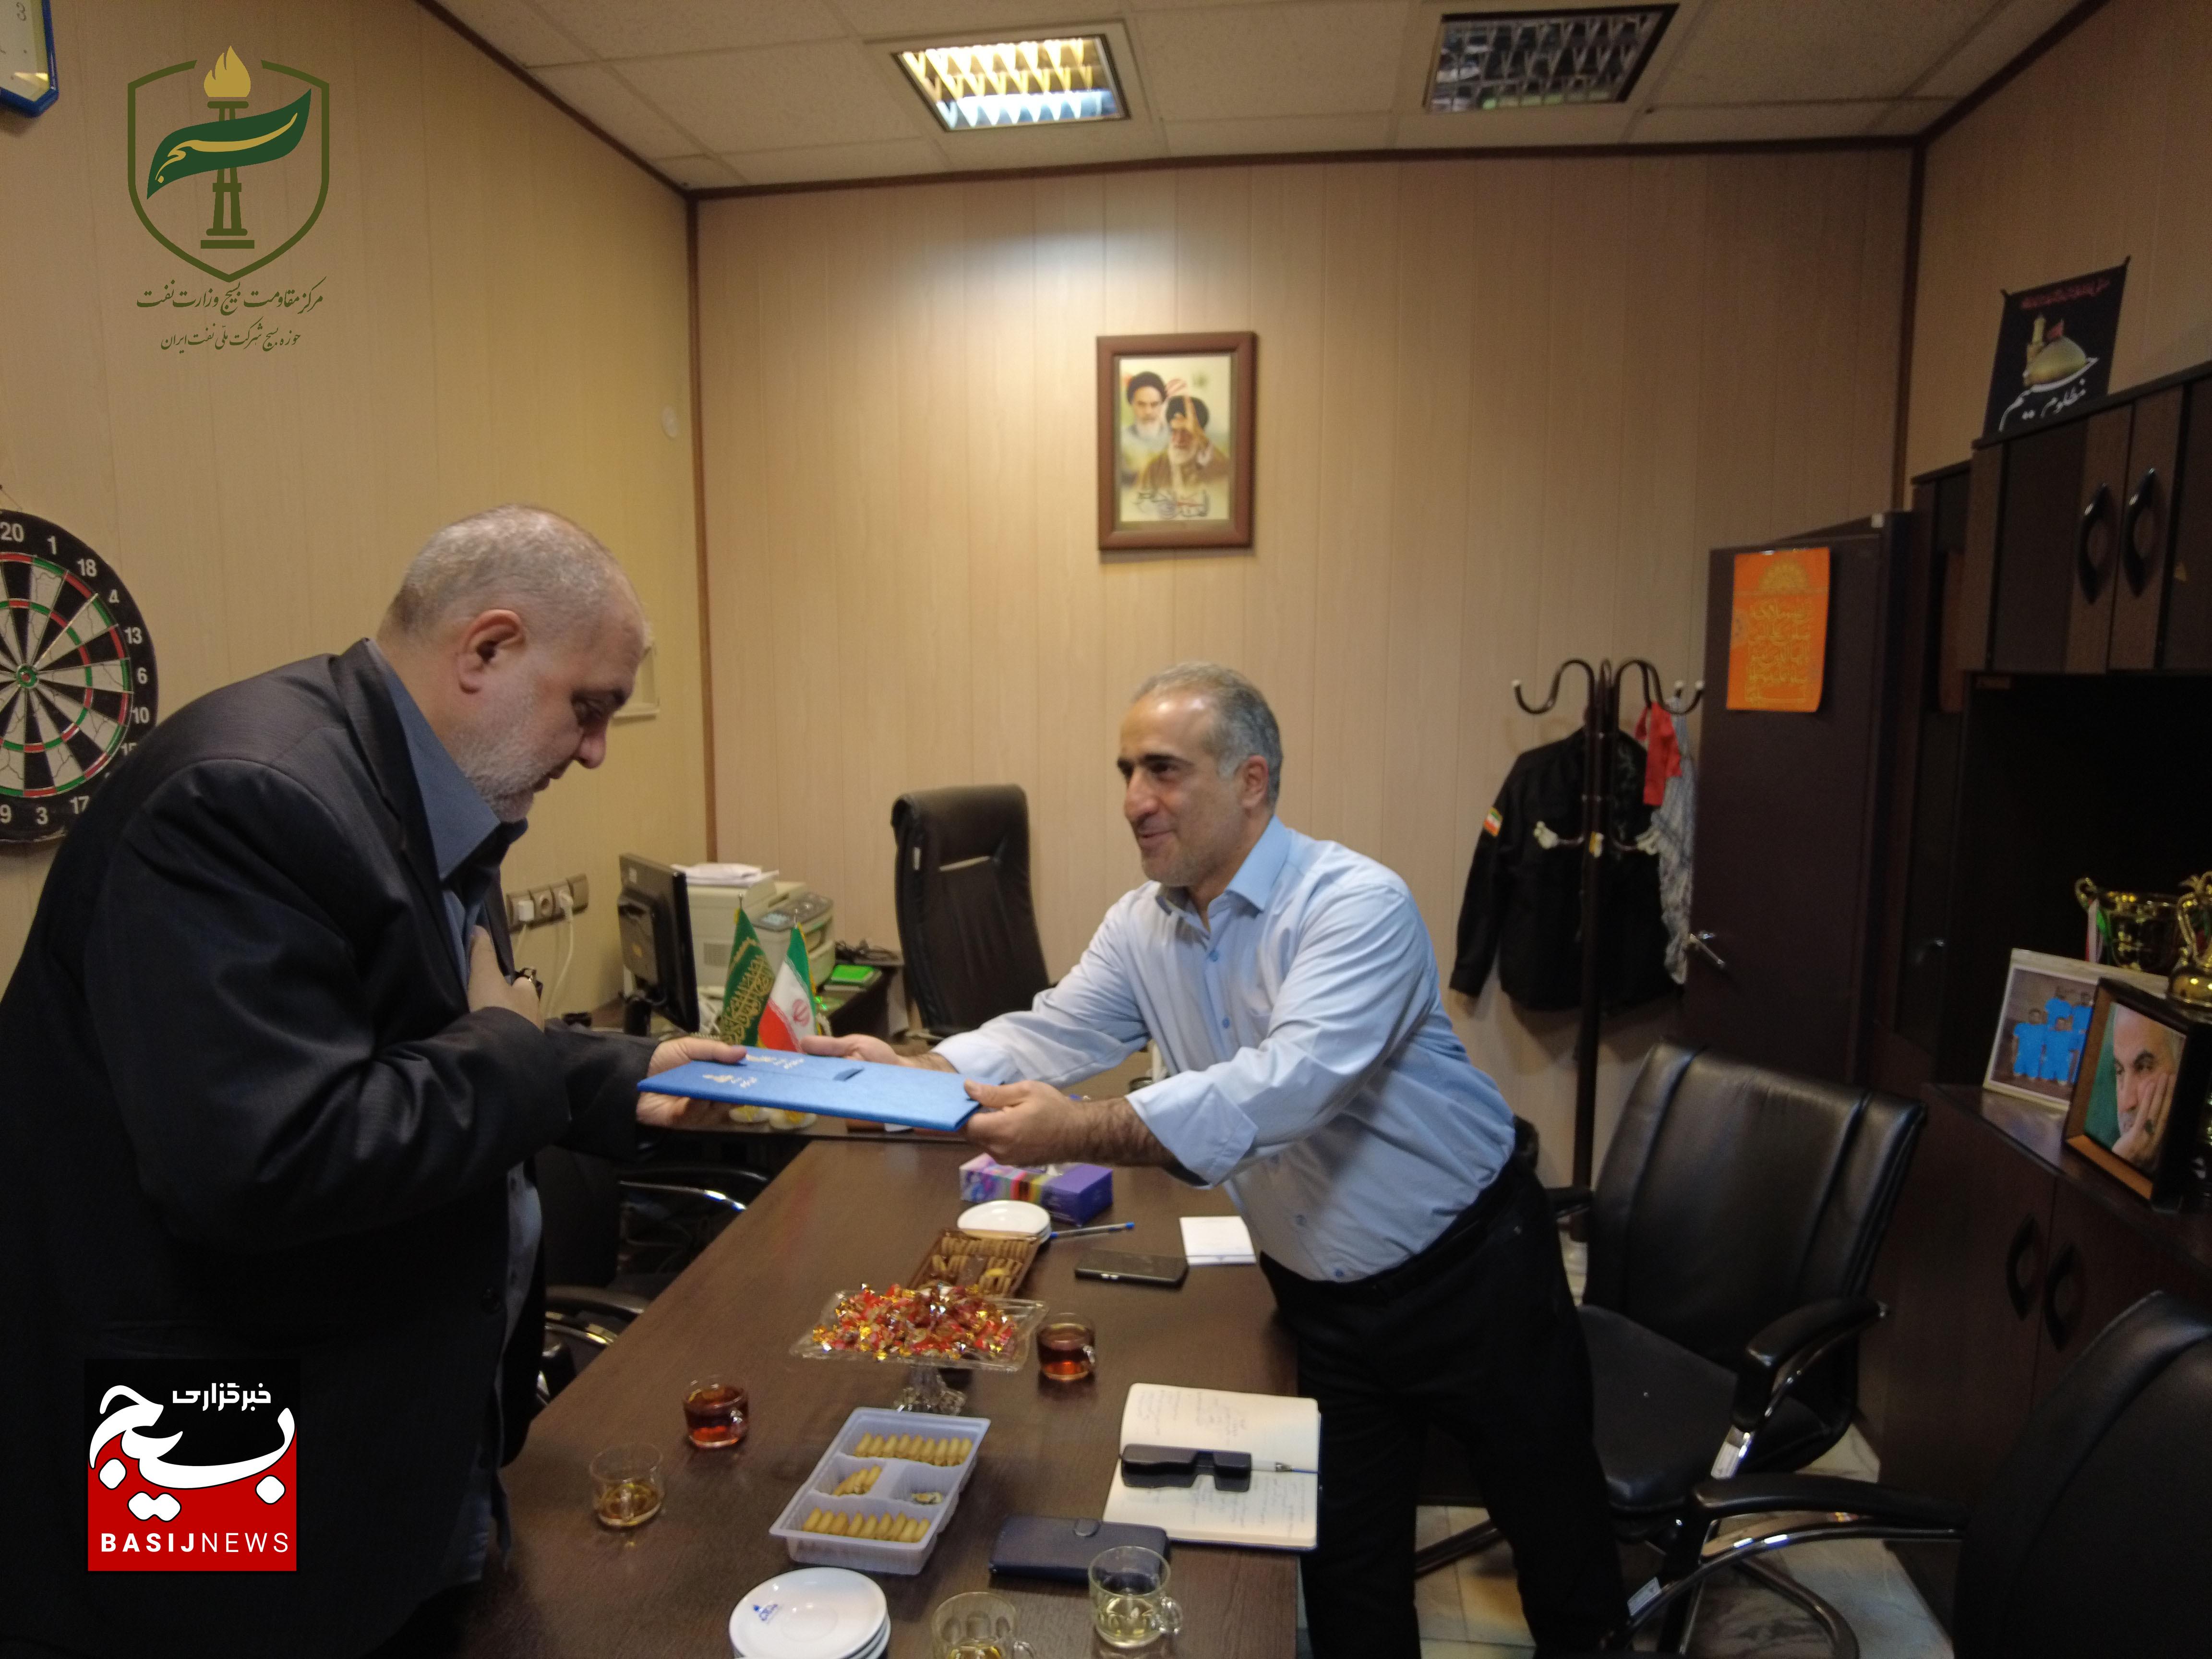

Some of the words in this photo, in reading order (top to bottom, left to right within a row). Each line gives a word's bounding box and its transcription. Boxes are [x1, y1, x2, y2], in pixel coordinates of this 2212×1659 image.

[0, 521, 24, 543] 20
[47, 535, 57, 555] 1
[77, 558, 98, 577] 18
[108, 589, 120, 604] 4
[124, 626, 143, 645] 13
[137, 667, 147, 685] 6
[132, 706, 150, 724] 10
[69, 795, 90, 815] 17
[36, 806, 48, 825] 3
